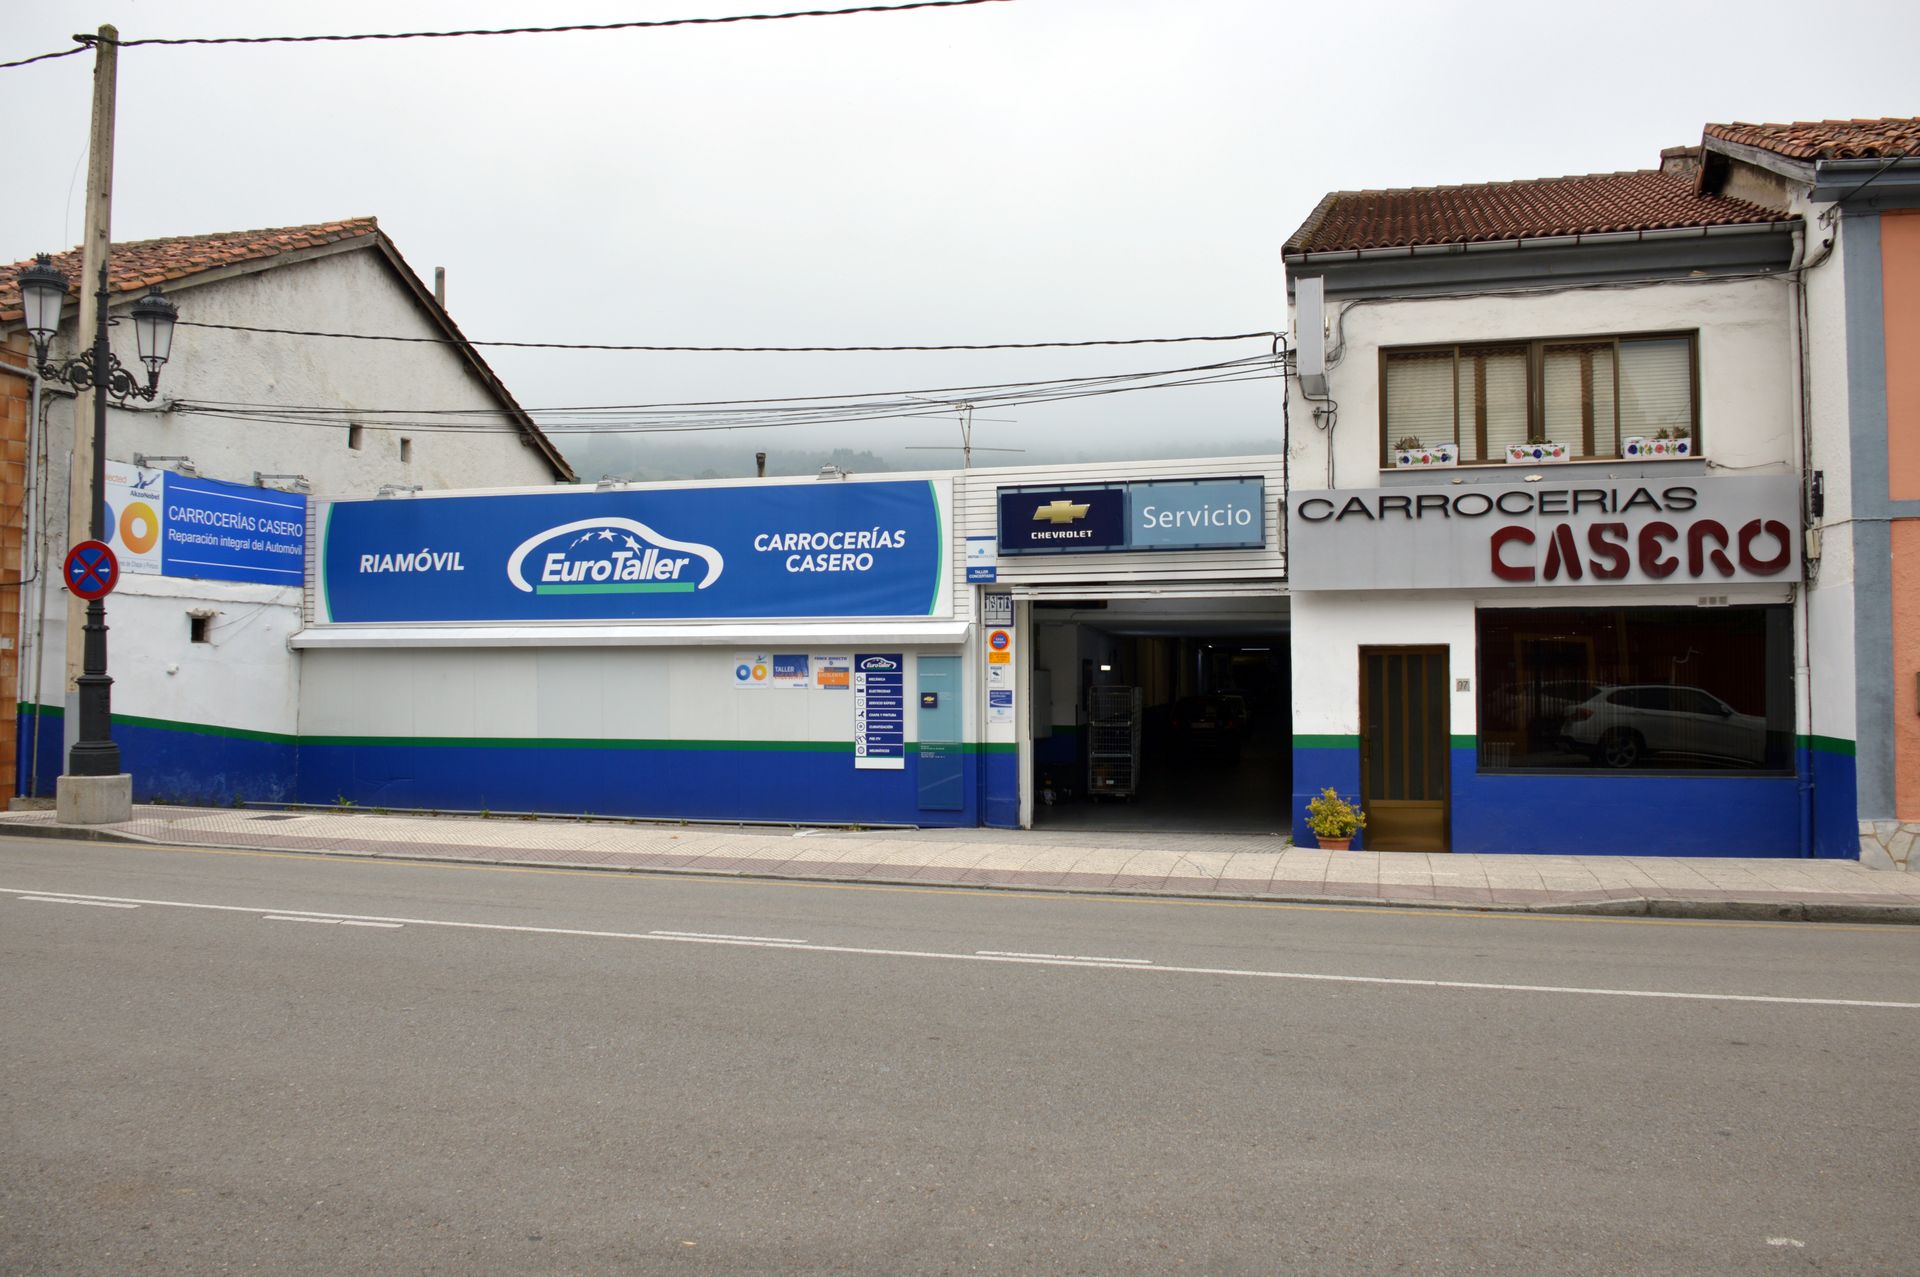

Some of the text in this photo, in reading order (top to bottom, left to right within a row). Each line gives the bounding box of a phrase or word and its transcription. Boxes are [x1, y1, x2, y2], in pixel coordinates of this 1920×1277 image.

[130, 490, 160, 500] AkzoNobel
[1297, 486, 1698, 522] CARROCERIAS
[168, 505, 303, 537] CARROCERÍAS CASERO
[1143, 504, 1251, 529] Servicio
[168, 528, 302, 555] Reparación integral del Automóvil
[754, 526, 906, 552] CARROCERÍAS
[1031, 530, 1092, 540] CHEVROLET
[360, 548, 464, 573] RIAMÓVIL
[1490, 518, 1792, 581] CASERO
[541, 549, 690, 582] EuroTaller
[786, 553, 874, 573] CASERO
